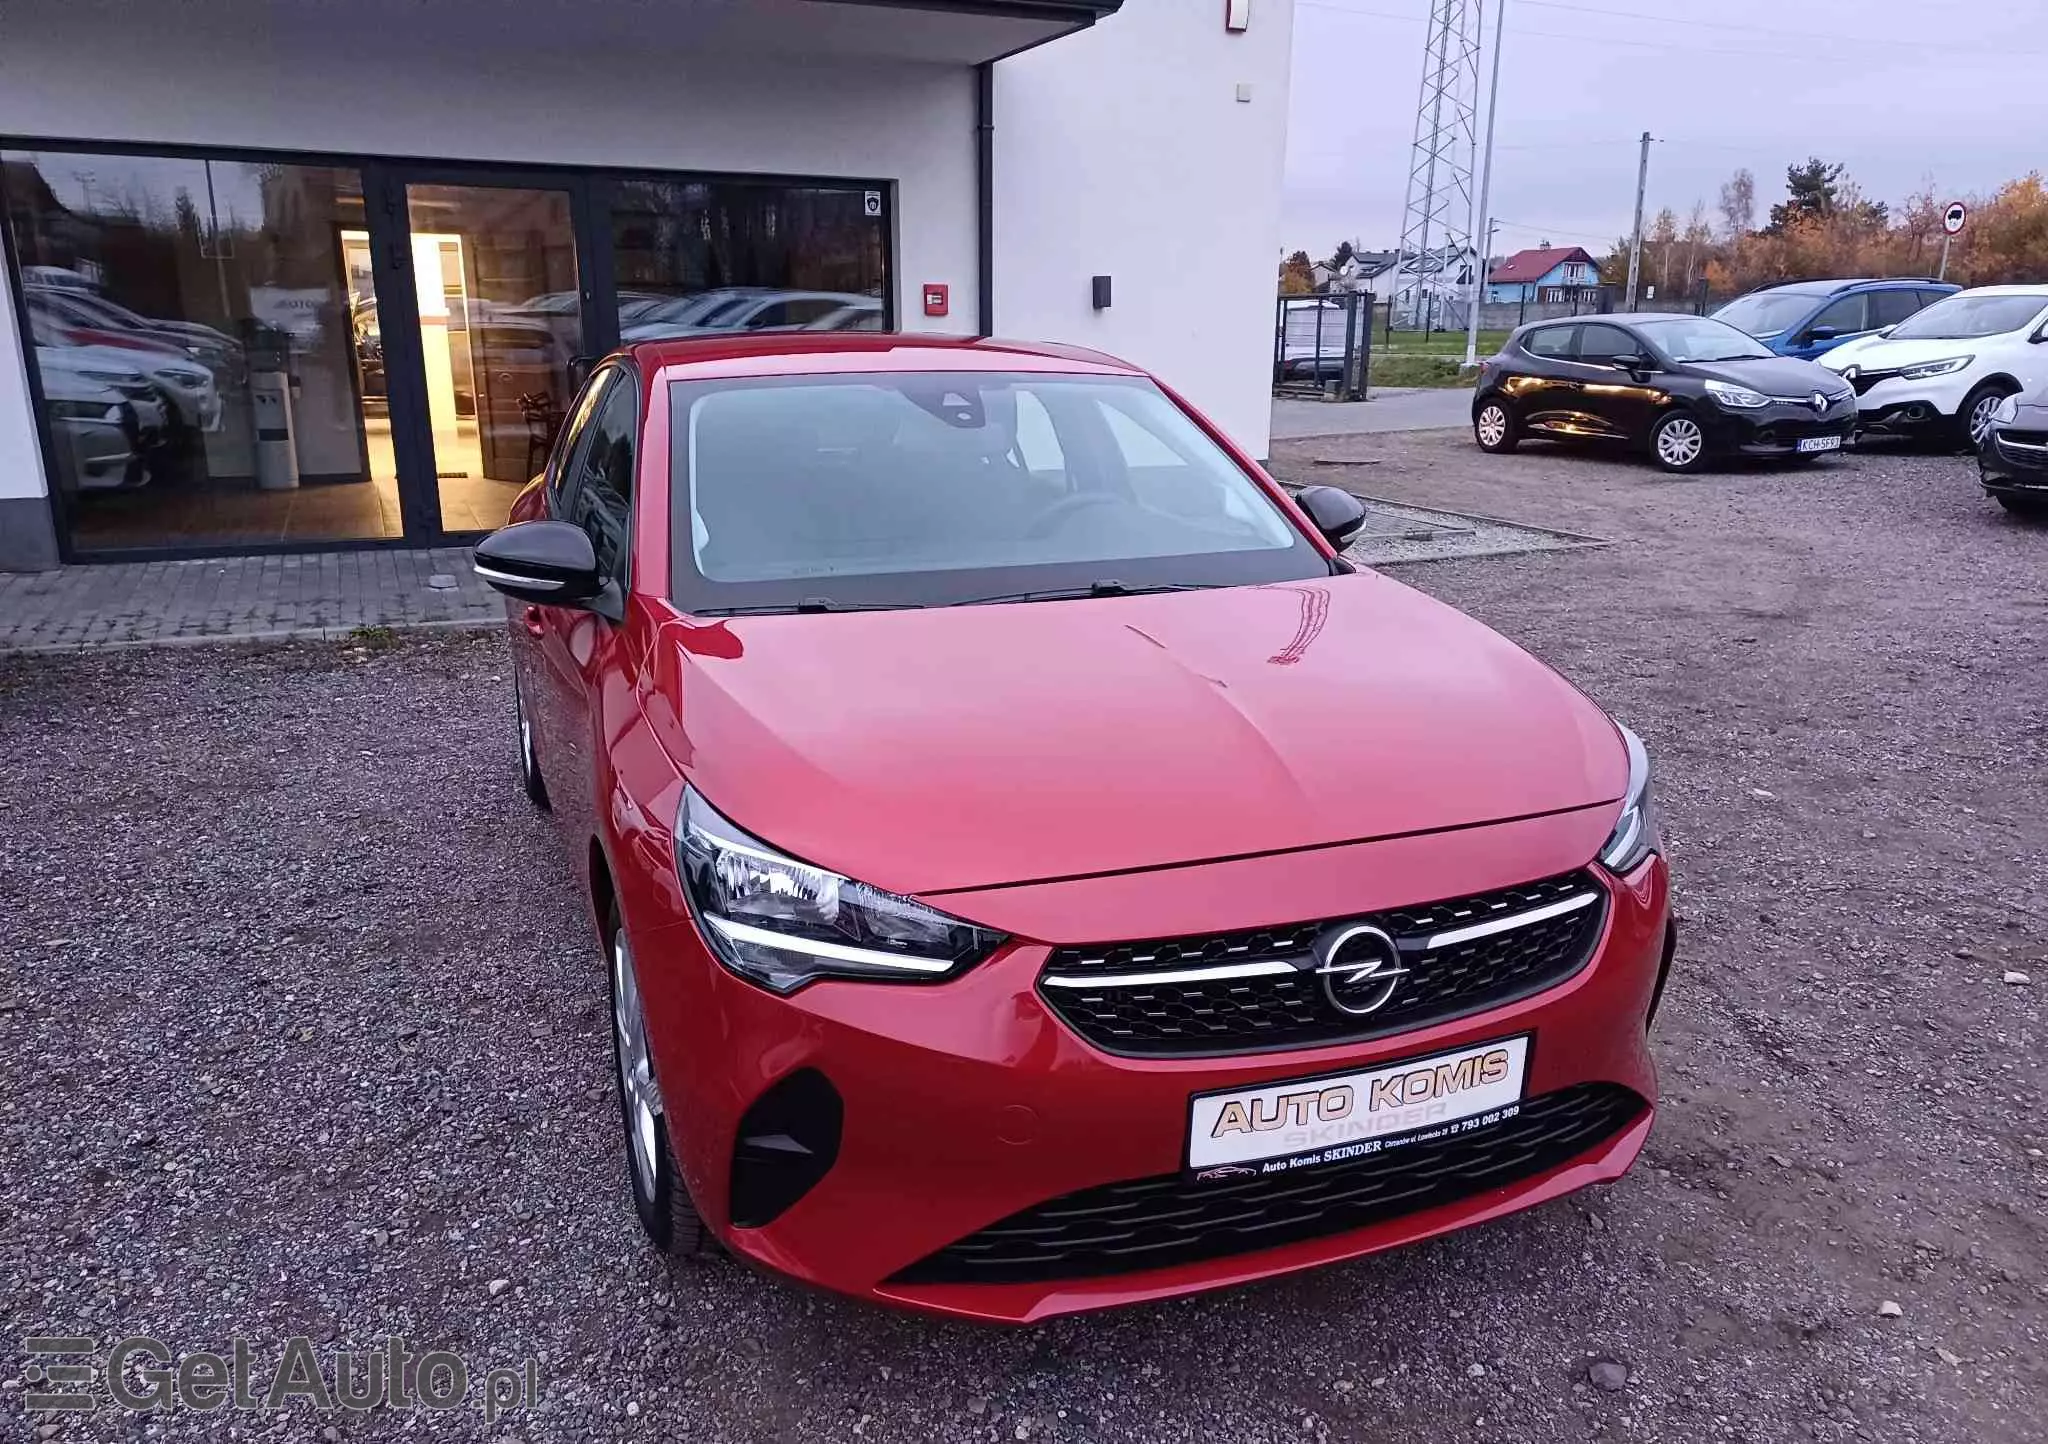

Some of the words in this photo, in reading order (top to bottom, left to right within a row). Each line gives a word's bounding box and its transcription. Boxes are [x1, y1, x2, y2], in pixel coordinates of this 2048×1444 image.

[1210, 1085, 1354, 1138] AUTO
[1369, 1048, 1509, 1112] KOMIS
[1262, 1161, 1287, 1174] Auto
[1289, 1155, 1321, 1169] Komis
[1323, 1141, 1382, 1162] SKINDER
[1461, 1119, 1480, 1132] 793
[1482, 1112, 1500, 1126] 002
[1285, 1103, 1447, 1147] SKINDER
